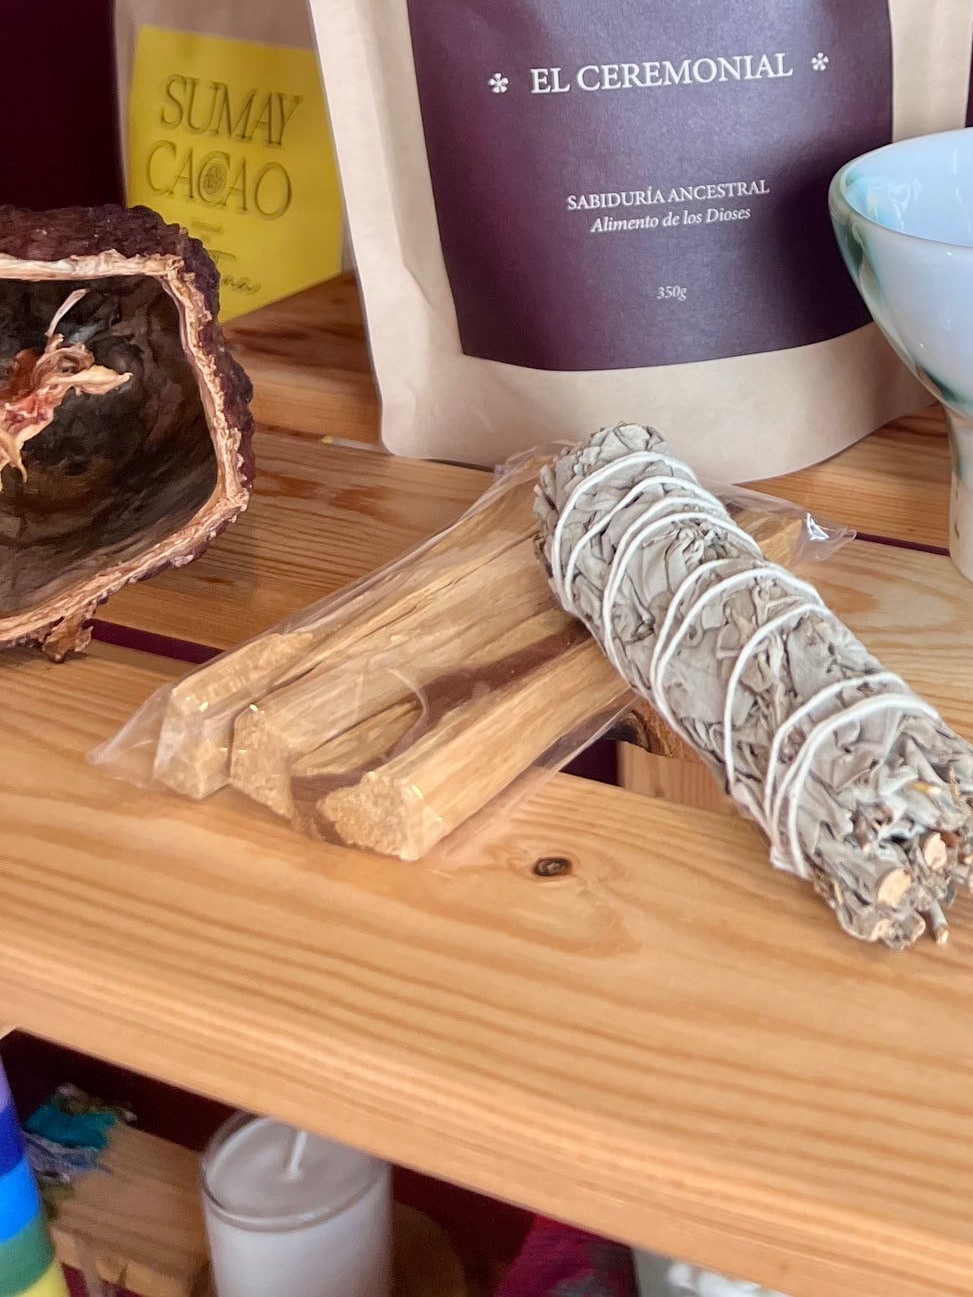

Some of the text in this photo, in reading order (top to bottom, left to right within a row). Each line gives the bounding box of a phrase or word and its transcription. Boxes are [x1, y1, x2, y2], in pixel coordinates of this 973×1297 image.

[531, 52, 794, 94] EL CEREMONIAL
[160, 74, 303, 146] SUMAY
[146, 139, 293, 220] CACAO
[567, 180, 770, 210] SABIDURÍA ANCESTRAL
[590, 207, 751, 233] Alimento de los Dioses
[656, 285, 688, 301] 350g
